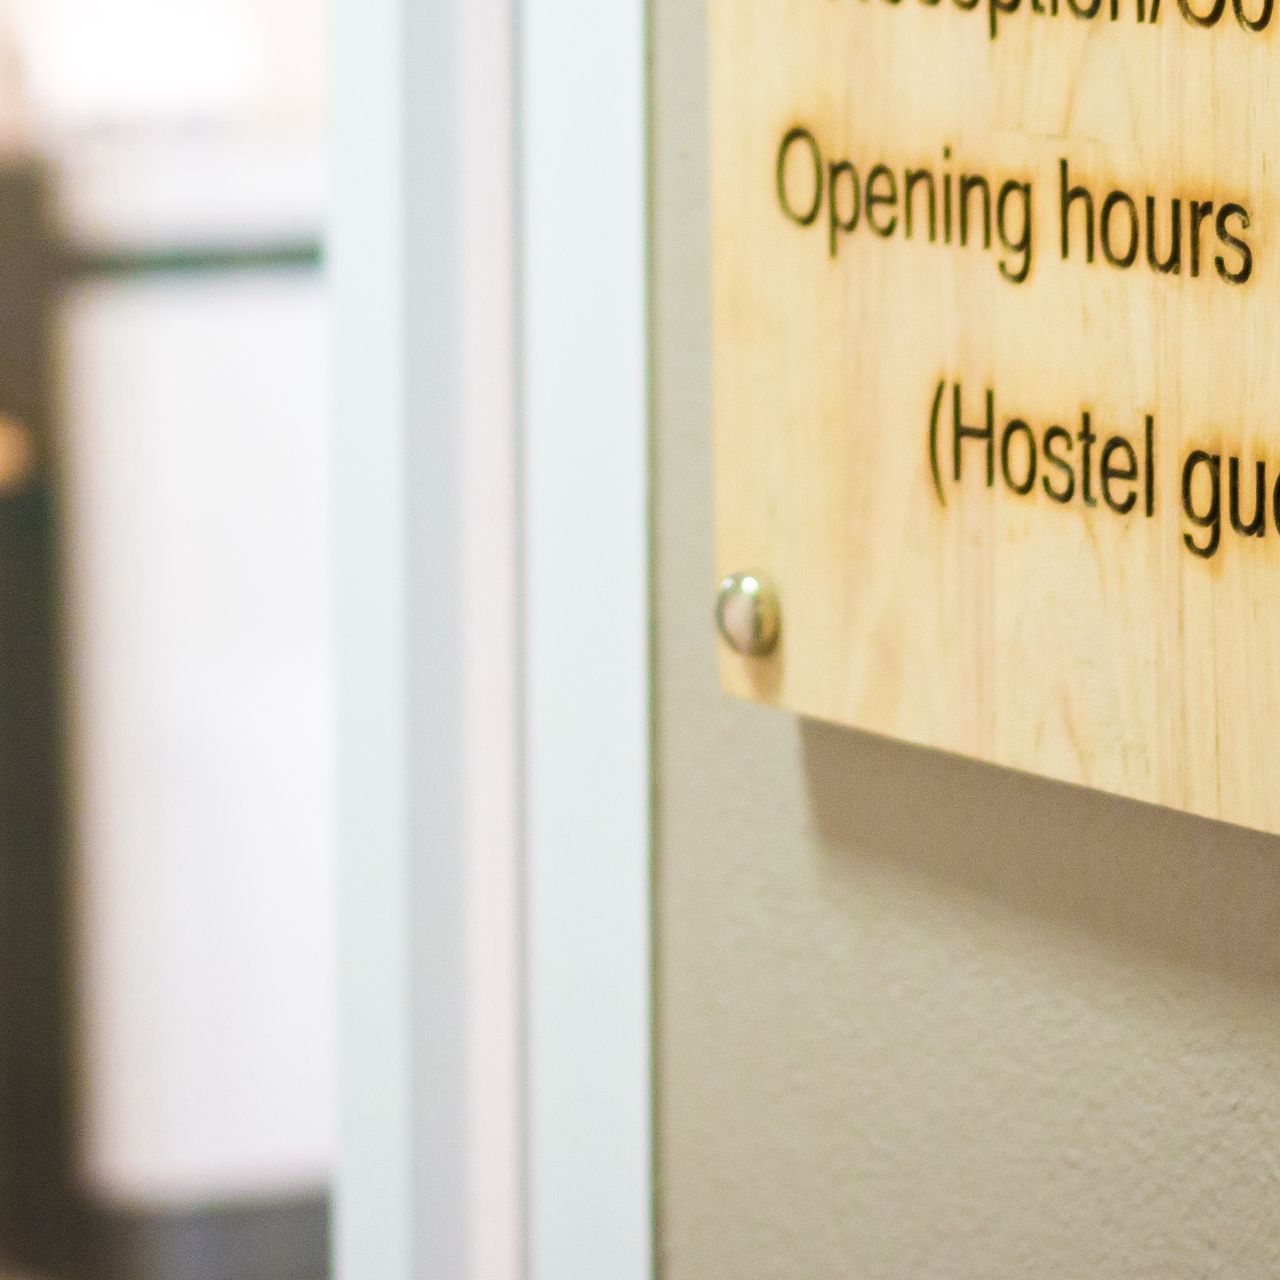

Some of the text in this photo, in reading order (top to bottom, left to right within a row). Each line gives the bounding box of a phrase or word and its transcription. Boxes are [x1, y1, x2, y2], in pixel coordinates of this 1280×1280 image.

[775, 127, 1032, 284] Opening
[1058, 158, 1253, 286] hours
[927, 379, 1154, 519] (Hostel
